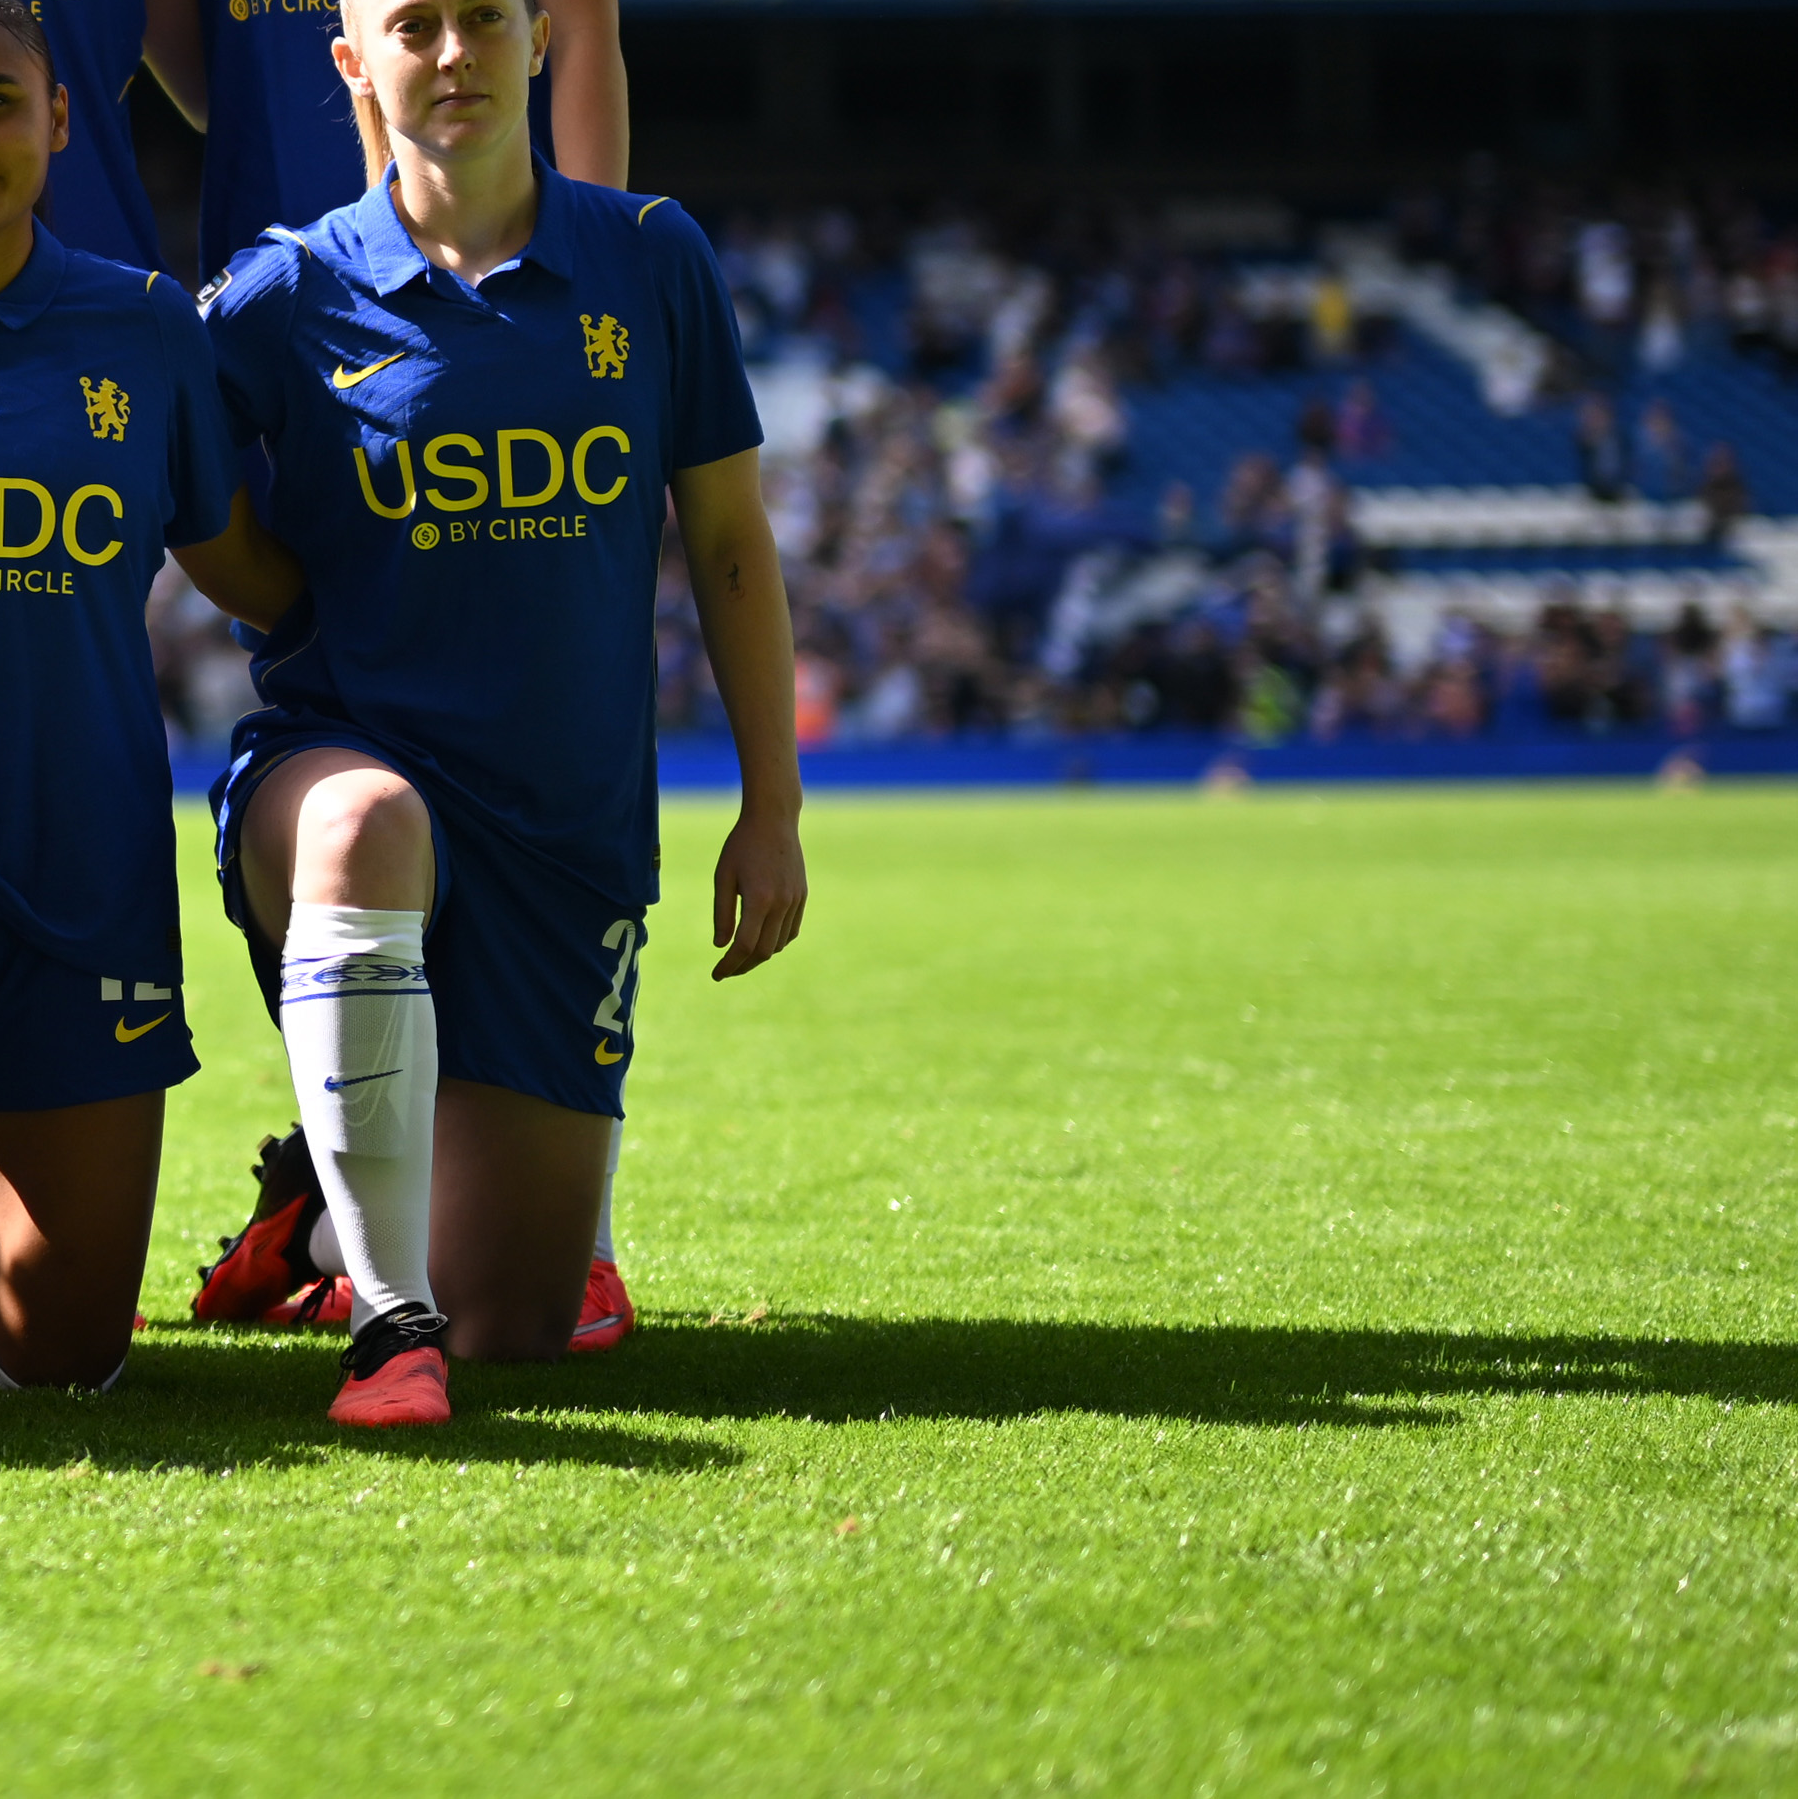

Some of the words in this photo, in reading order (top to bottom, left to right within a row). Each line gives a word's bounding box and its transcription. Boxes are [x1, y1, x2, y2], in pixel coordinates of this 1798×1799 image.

[353, 425, 631, 520] USDC
[450, 520, 481, 542] BY
[489, 515, 587, 541] CIRCLE
